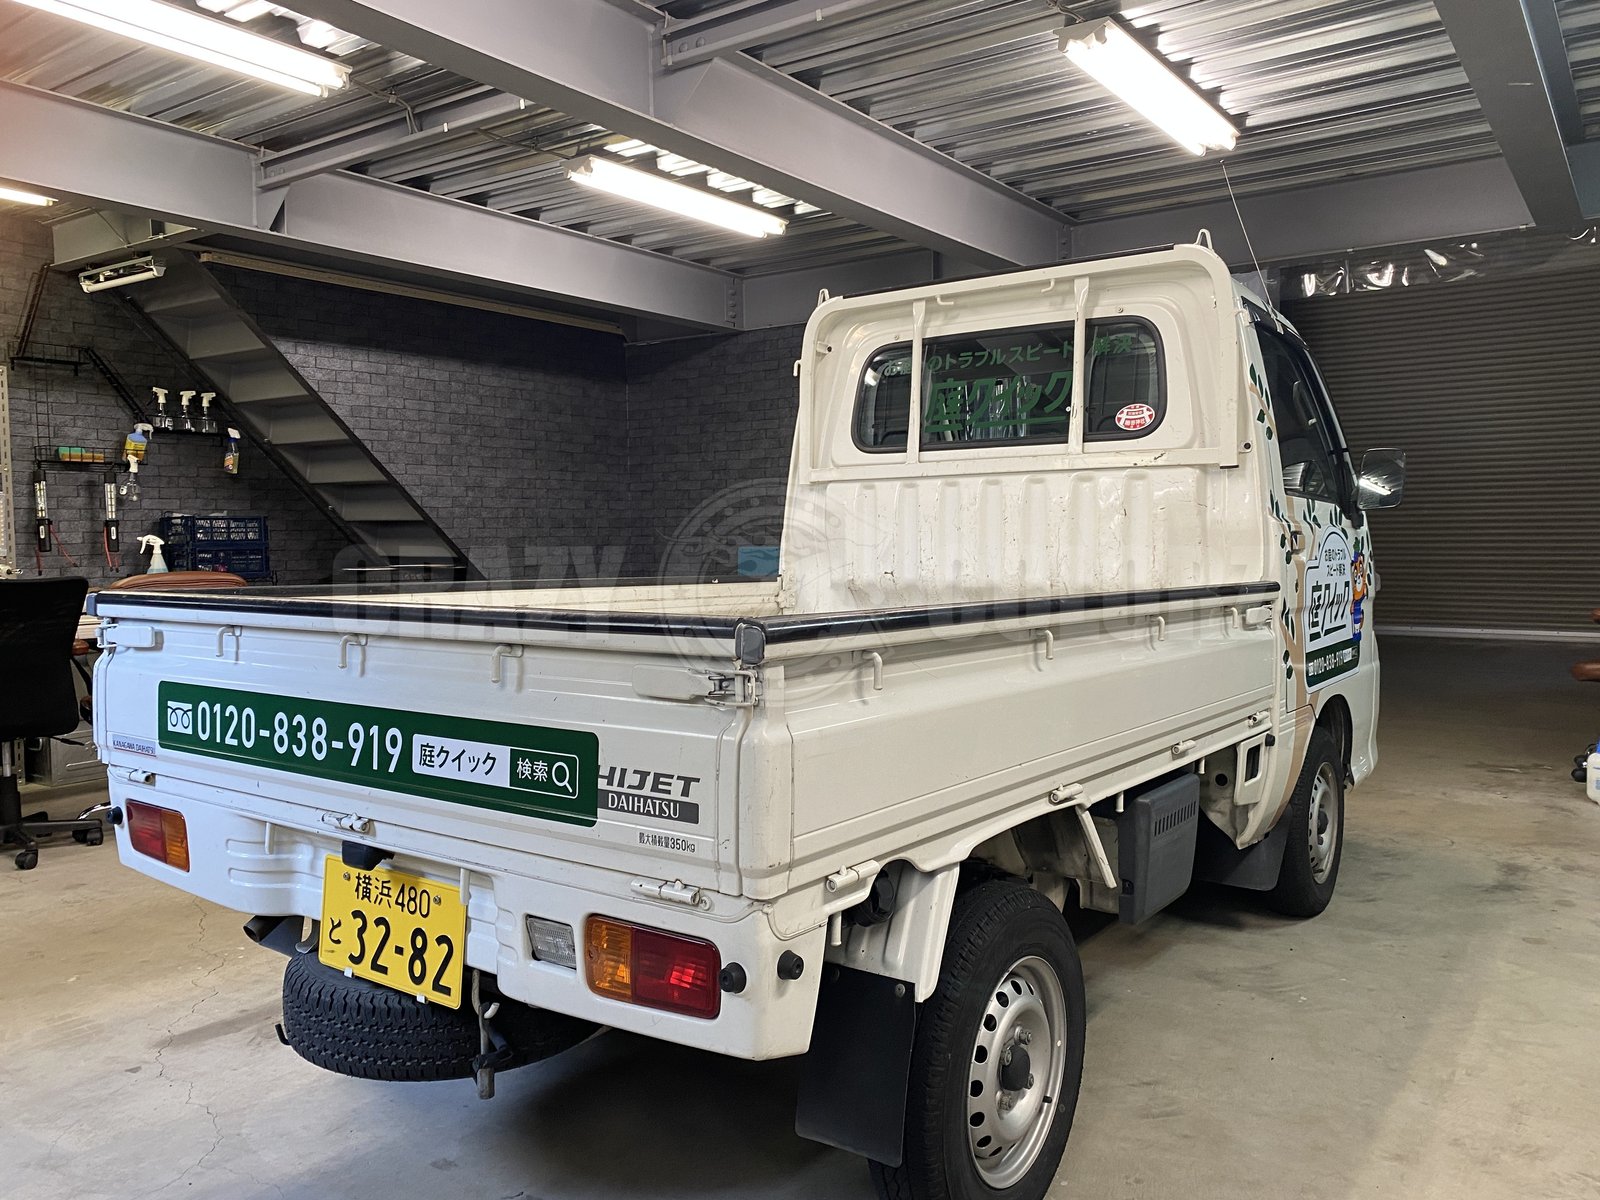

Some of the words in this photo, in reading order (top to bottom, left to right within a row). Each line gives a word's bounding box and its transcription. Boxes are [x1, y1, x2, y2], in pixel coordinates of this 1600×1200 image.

[1308, 580, 1350, 634] 庭クイック
[198, 700, 403, 773] 0120-838-919
[418, 743, 497, 776] 庭クイック
[516, 757, 548, 782] 検索
[598, 764, 701, 798] HIJET
[608, 792, 680, 819] DAIHATSU
[328, 917, 342, 944] と
[348, 909, 454, 997] 32-82
